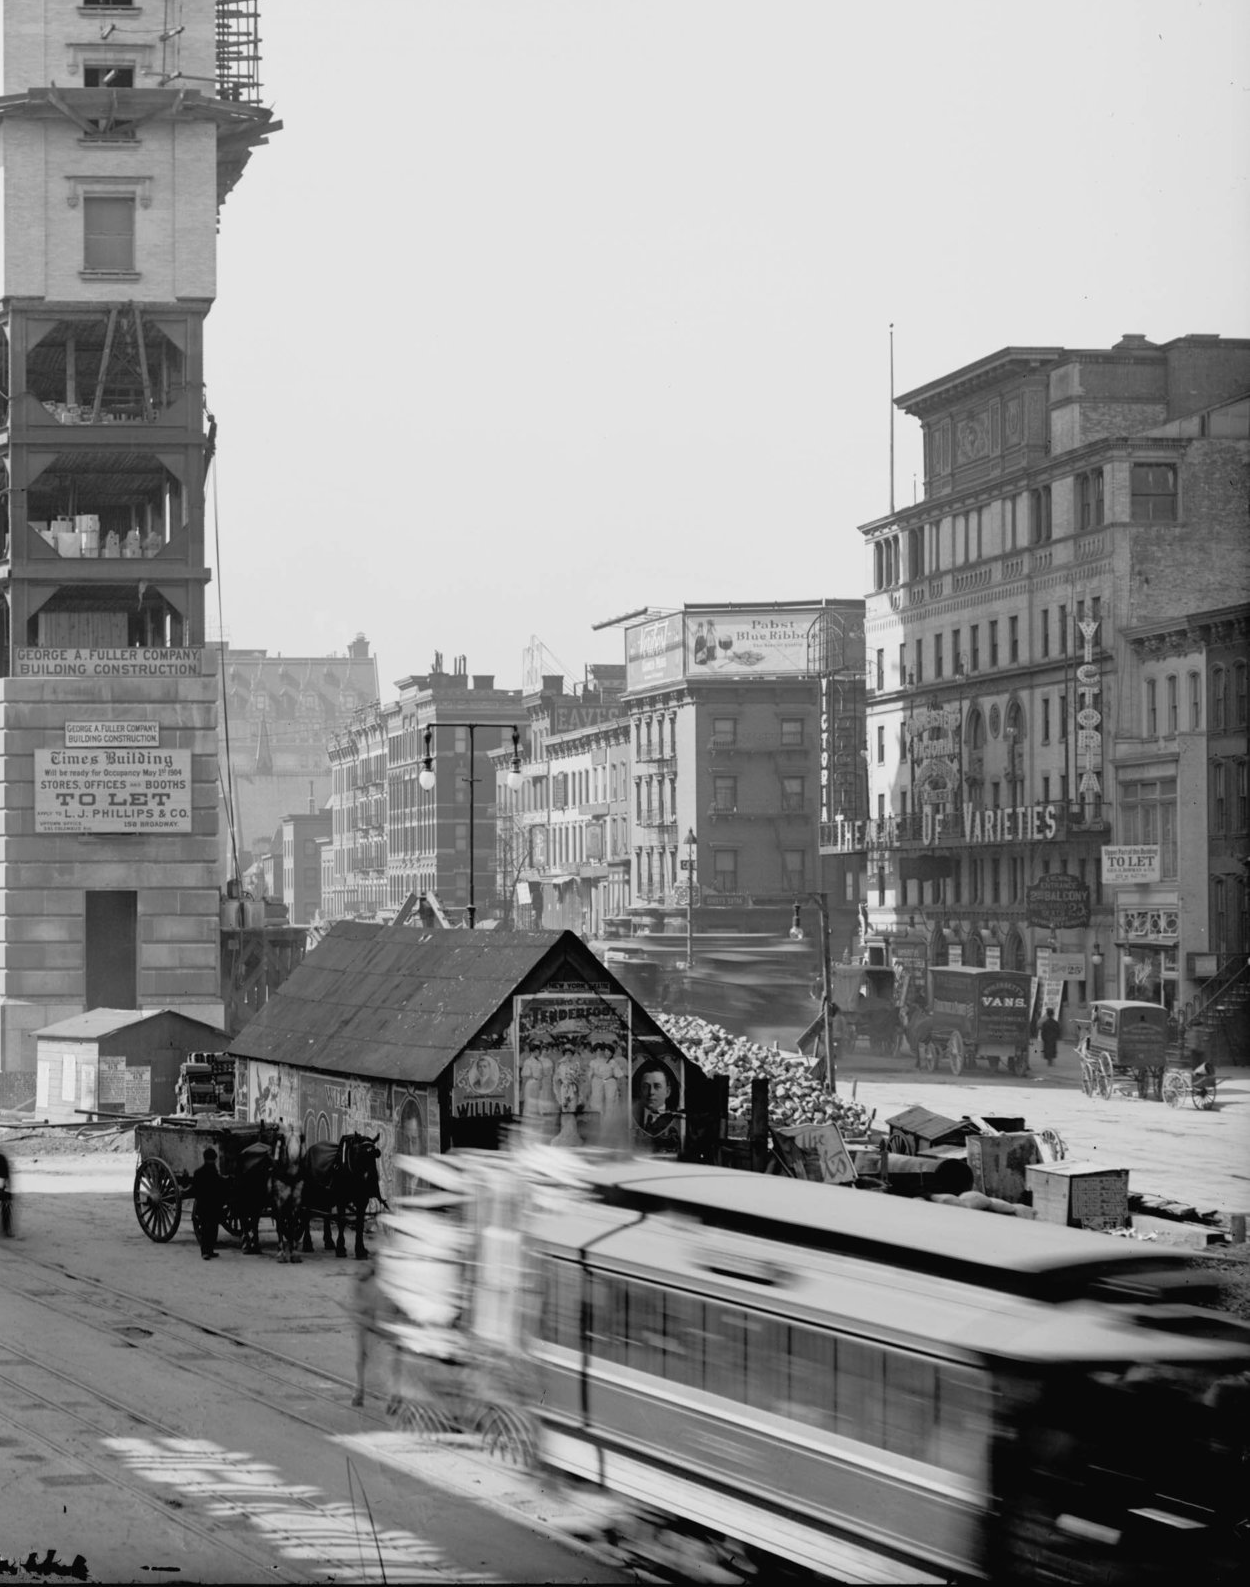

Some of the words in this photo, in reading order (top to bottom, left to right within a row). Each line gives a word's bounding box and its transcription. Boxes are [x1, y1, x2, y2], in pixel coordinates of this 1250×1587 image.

[752, 619, 794, 630] Pabst
[736, 630, 766, 641] Blue
[17, 649, 68, 661] GEORGE
[89, 649, 138, 661] FULLER
[20, 664, 87, 675] BUILDING
[1076, 621, 1102, 793] VICTORIA
[66, 724, 93, 733] GEORGE
[101, 724, 126, 733] FULLER
[68, 734, 102, 743] BUILDING
[820, 677, 828, 823] VICTORIA
[50, 751, 99, 765] Times
[104, 751, 174, 768] Building
[44, 768, 57, 777] Will
[59, 769, 67, 777] be
[68, 769, 89, 778] ready
[91, 769, 101, 777] for
[103, 769, 141, 778] Occupancy
[142, 769, 156, 778] May
[167, 769, 182, 777] 1904
[84, 780, 127, 790] OFFICES
[145, 780, 186, 790] BOOTHS
[55, 793, 97, 806] TO
[108, 793, 171, 806] LET
[92, 809, 155, 819] PHILLIPS
[158, 809, 167, 819] &
[170, 809, 190, 819] CO.
[922, 806, 944, 846] OF
[963, 804, 1056, 844] VARIETIES
[1108, 856, 1125, 867] TO
[1128, 855, 1155, 867] LET
[1044, 890, 1088, 902] BALCONY
[981, 996, 1028, 1008] VANS.
[456, 1100, 512, 1117] WILLIAM
